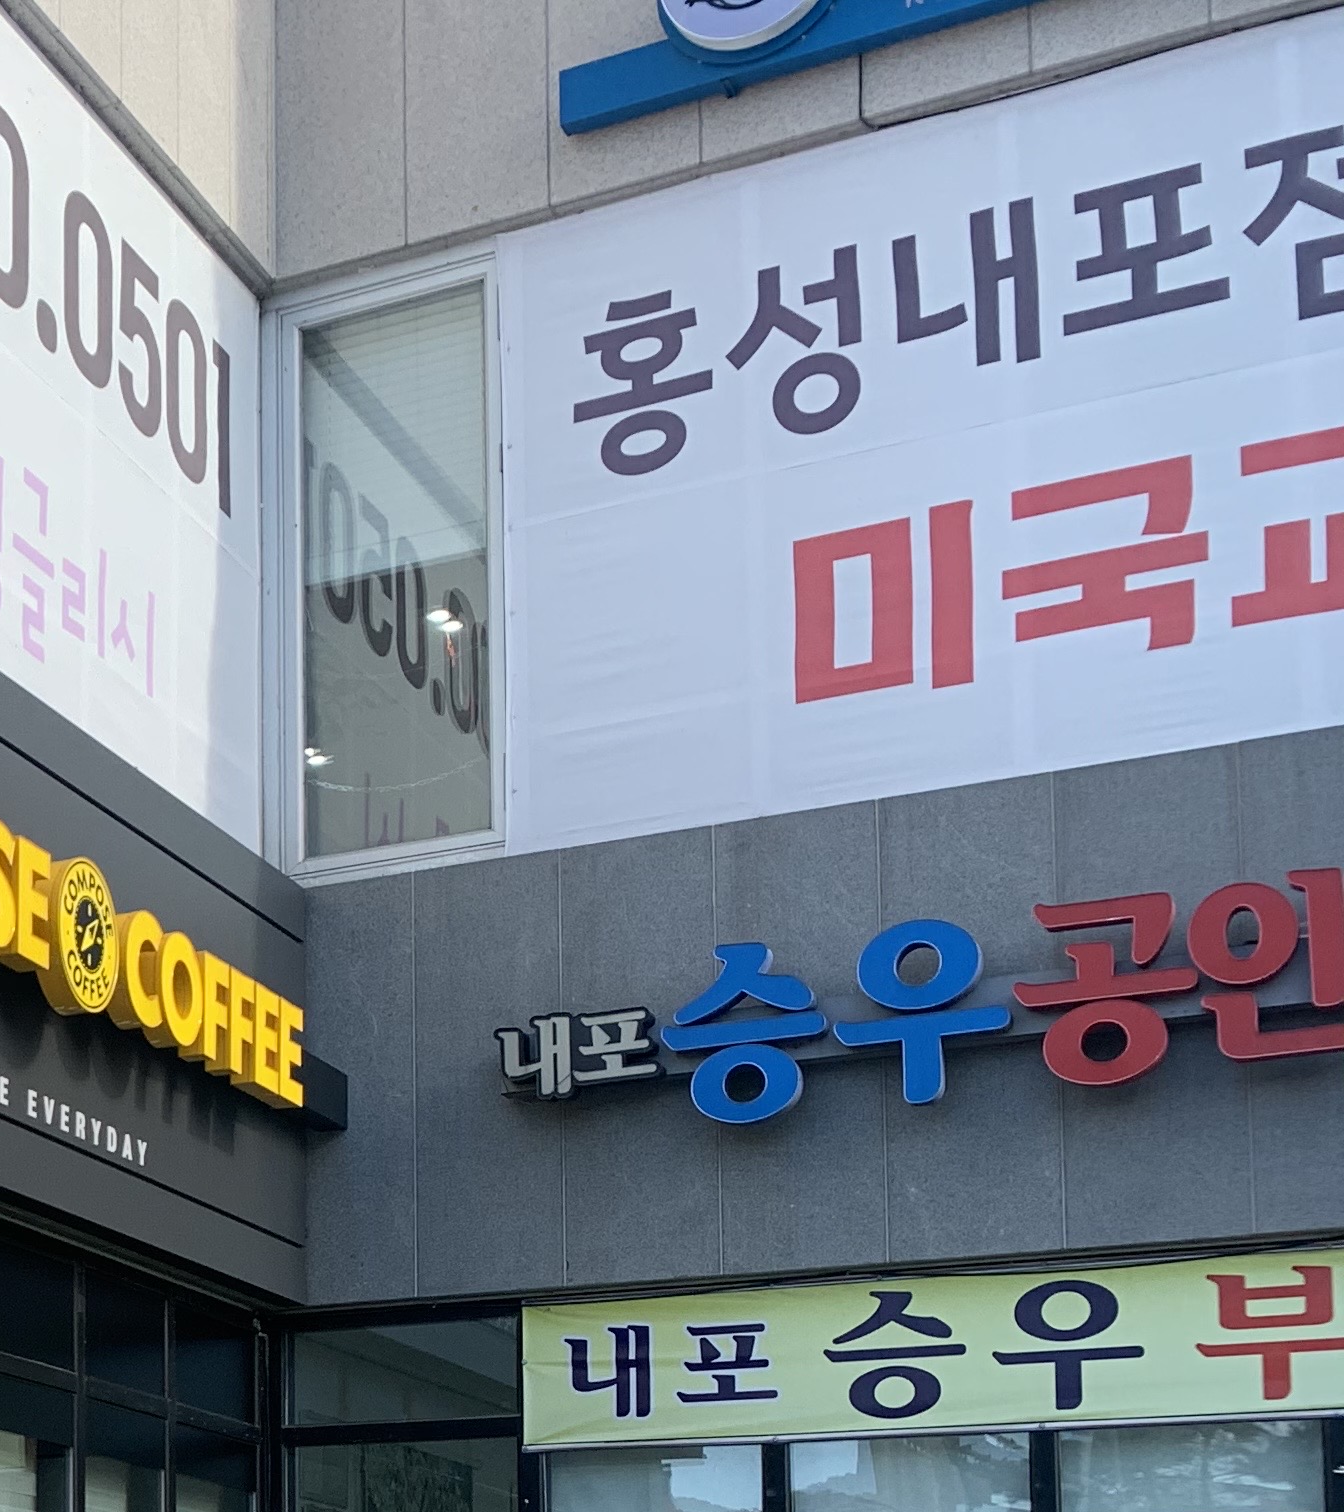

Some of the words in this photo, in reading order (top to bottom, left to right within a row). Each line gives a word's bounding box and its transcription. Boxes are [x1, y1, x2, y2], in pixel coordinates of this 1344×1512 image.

[62, 868, 115, 940] COMPOSE
[67, 949, 110, 1003] COFFEE
[110, 910, 305, 1109] COFFEE
[498, 1008, 662, 1098] 내포
[661, 919, 1014, 1125] 승우
[27, 1088, 150, 1168] EVERYDAY
[563, 1323, 778, 1418] 내포
[823, 1280, 1145, 1420] 승우
